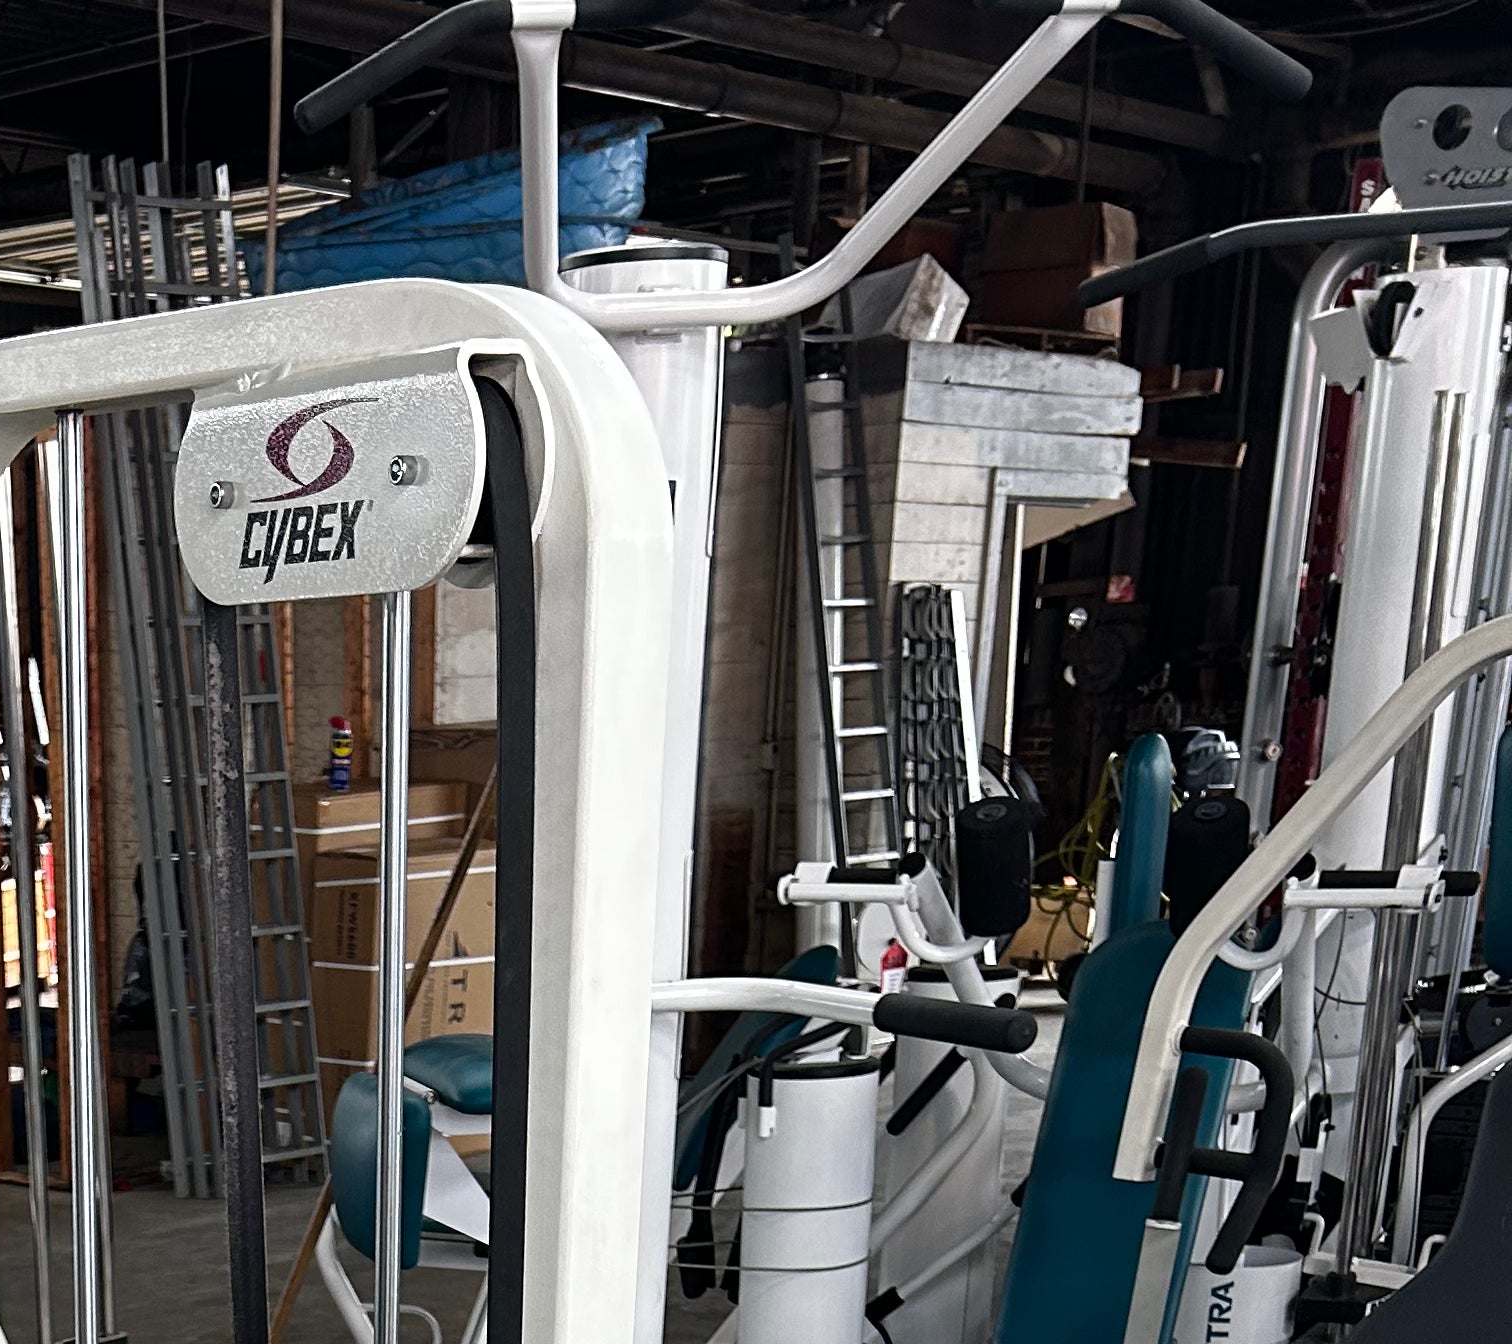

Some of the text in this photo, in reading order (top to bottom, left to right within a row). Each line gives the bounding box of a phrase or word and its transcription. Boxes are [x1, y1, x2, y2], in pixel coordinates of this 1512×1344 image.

[1440, 165, 1512, 189] HOIS
[239, 500, 364, 584] CYBEX
[448, 968, 468, 1024] TR
